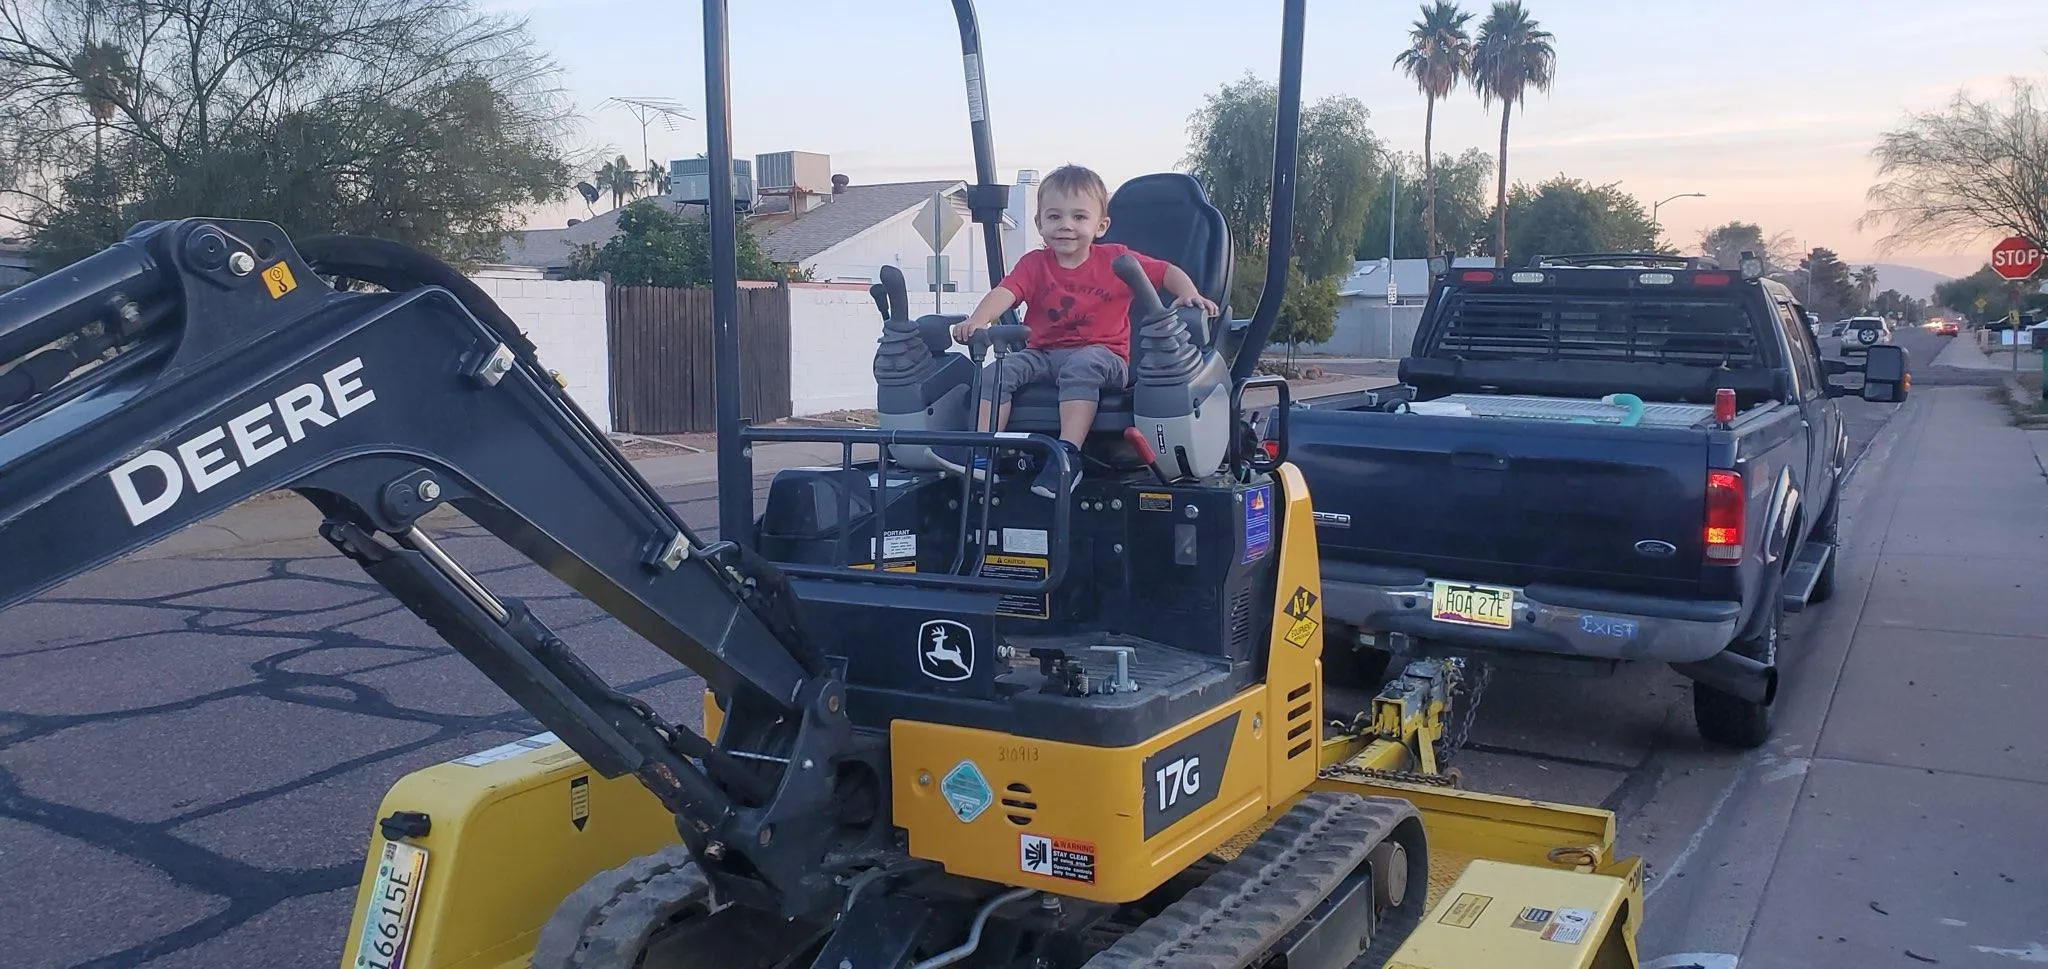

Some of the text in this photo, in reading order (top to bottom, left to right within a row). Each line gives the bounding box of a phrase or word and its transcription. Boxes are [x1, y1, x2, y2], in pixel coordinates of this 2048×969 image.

[1995, 249, 2039, 266] STOP
[109, 357, 377, 527] DEERE
[1312, 511, 1350, 526] 250
[883, 529, 910, 537] PORTANT
[1582, 614, 1634, 637] EXIST
[1156, 757, 1200, 811] 17G
[1059, 840, 1095, 853] WARNING
[1053, 850, 1088, 861] STAY CLEAR
[369, 866, 412, 969] 16615E
